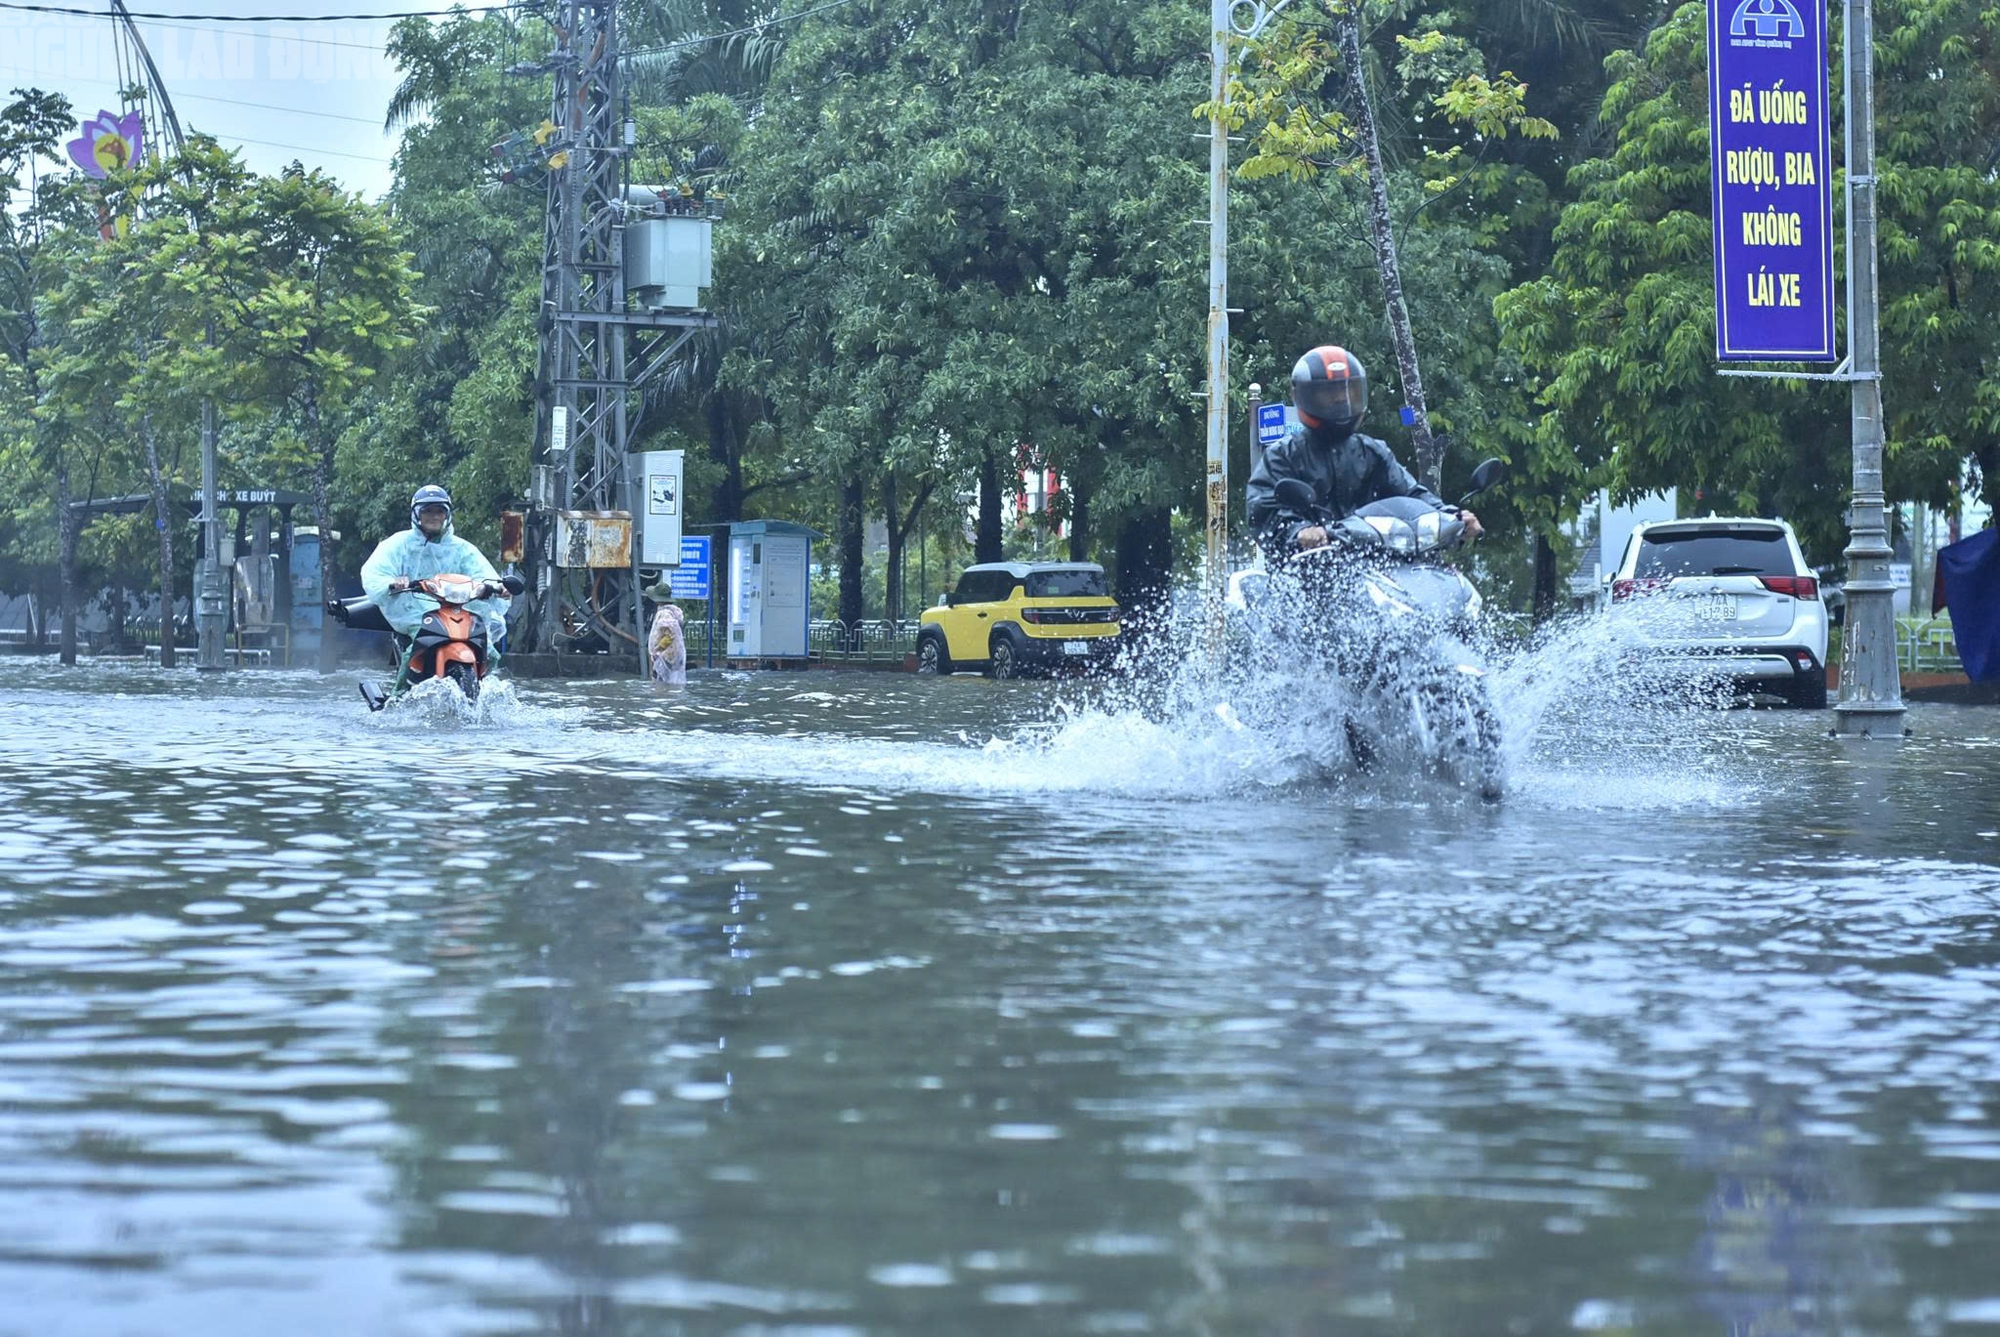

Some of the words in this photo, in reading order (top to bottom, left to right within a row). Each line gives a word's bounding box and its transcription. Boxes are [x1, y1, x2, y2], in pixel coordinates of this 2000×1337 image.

[1729, 82, 1754, 123] ĐÃ
[1759, 78, 1807, 124] UỐNG
[1726, 146, 1780, 192] RƯỢU,
[1784, 151, 1816, 185] BIA
[1742, 204, 1802, 246] KHÔNG
[1747, 265, 1775, 307] LÁI
[1778, 273, 1801, 307] XE
[235, 490, 248, 502] XE
[250, 488, 276, 502] BUÝT
